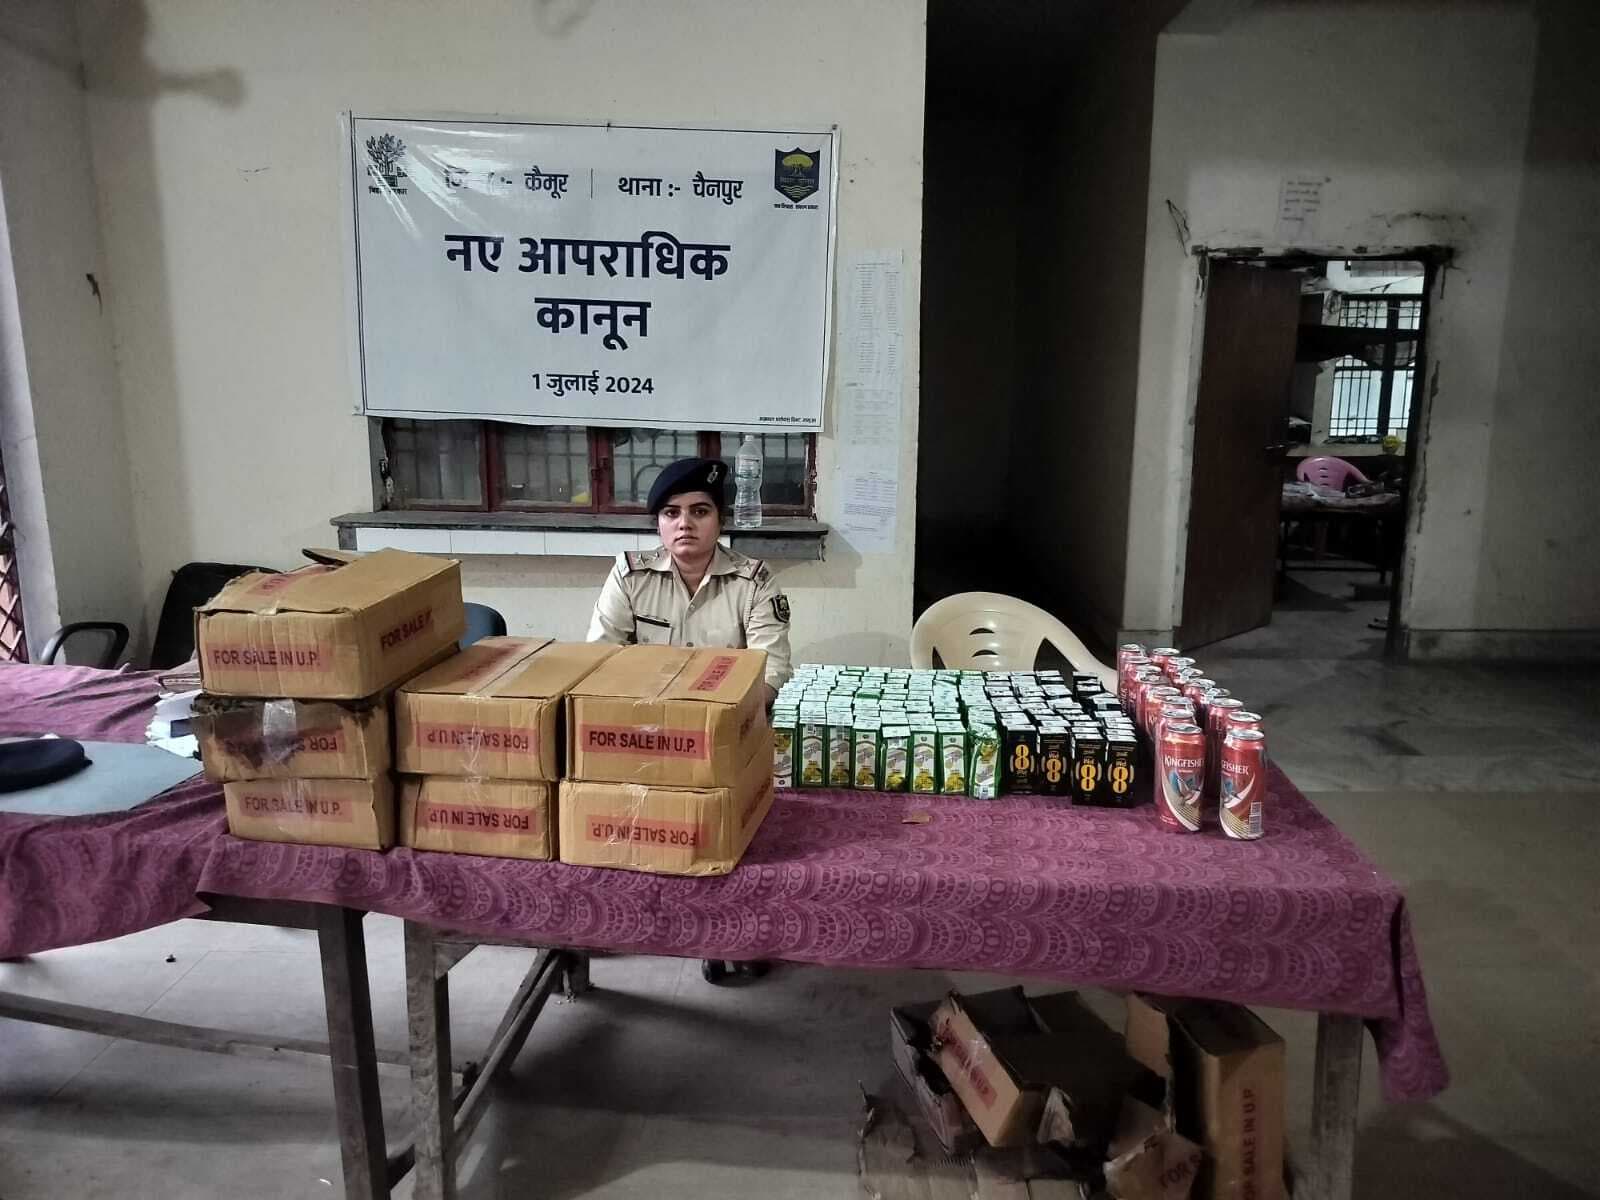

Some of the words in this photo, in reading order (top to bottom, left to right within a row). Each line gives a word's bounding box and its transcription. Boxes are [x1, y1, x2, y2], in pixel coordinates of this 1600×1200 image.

[524, 165, 568, 199] कैमूर
[618, 176, 662, 197] थाना
[692, 170, 744, 205] चैनपुर
[444, 234, 504, 273] नए
[518, 230, 731, 281] आपराधिक
[534, 297, 651, 350] कानून
[532, 373, 540, 390] 1
[546, 369, 600, 397] जुलाई
[605, 376, 654, 394] 2024
[213, 649, 241, 665] FOR
[243, 649, 277, 666] SALE
[280, 650, 294, 666] IN
[310, 737, 337, 750] FOR
[504, 733, 529, 750] FOR
[589, 731, 616, 747] FOR
[620, 733, 655, 750] SALE
[657, 735, 671, 751] IN
[673, 737, 697, 754] U.P.
[1165, 755, 1204, 768] KINGFISH
[245, 796, 270, 811] FOR
[270, 798, 303, 813] SALE
[451, 810, 464, 825] IN
[466, 811, 500, 828] SALE
[504, 814, 529, 830] FOR
[615, 824, 630, 841] IN
[633, 827, 665, 844] SALE
[670, 829, 697, 846] FOR
[1243, 1118, 1256, 1133] IN
[1243, 1136, 1256, 1177] SALE
